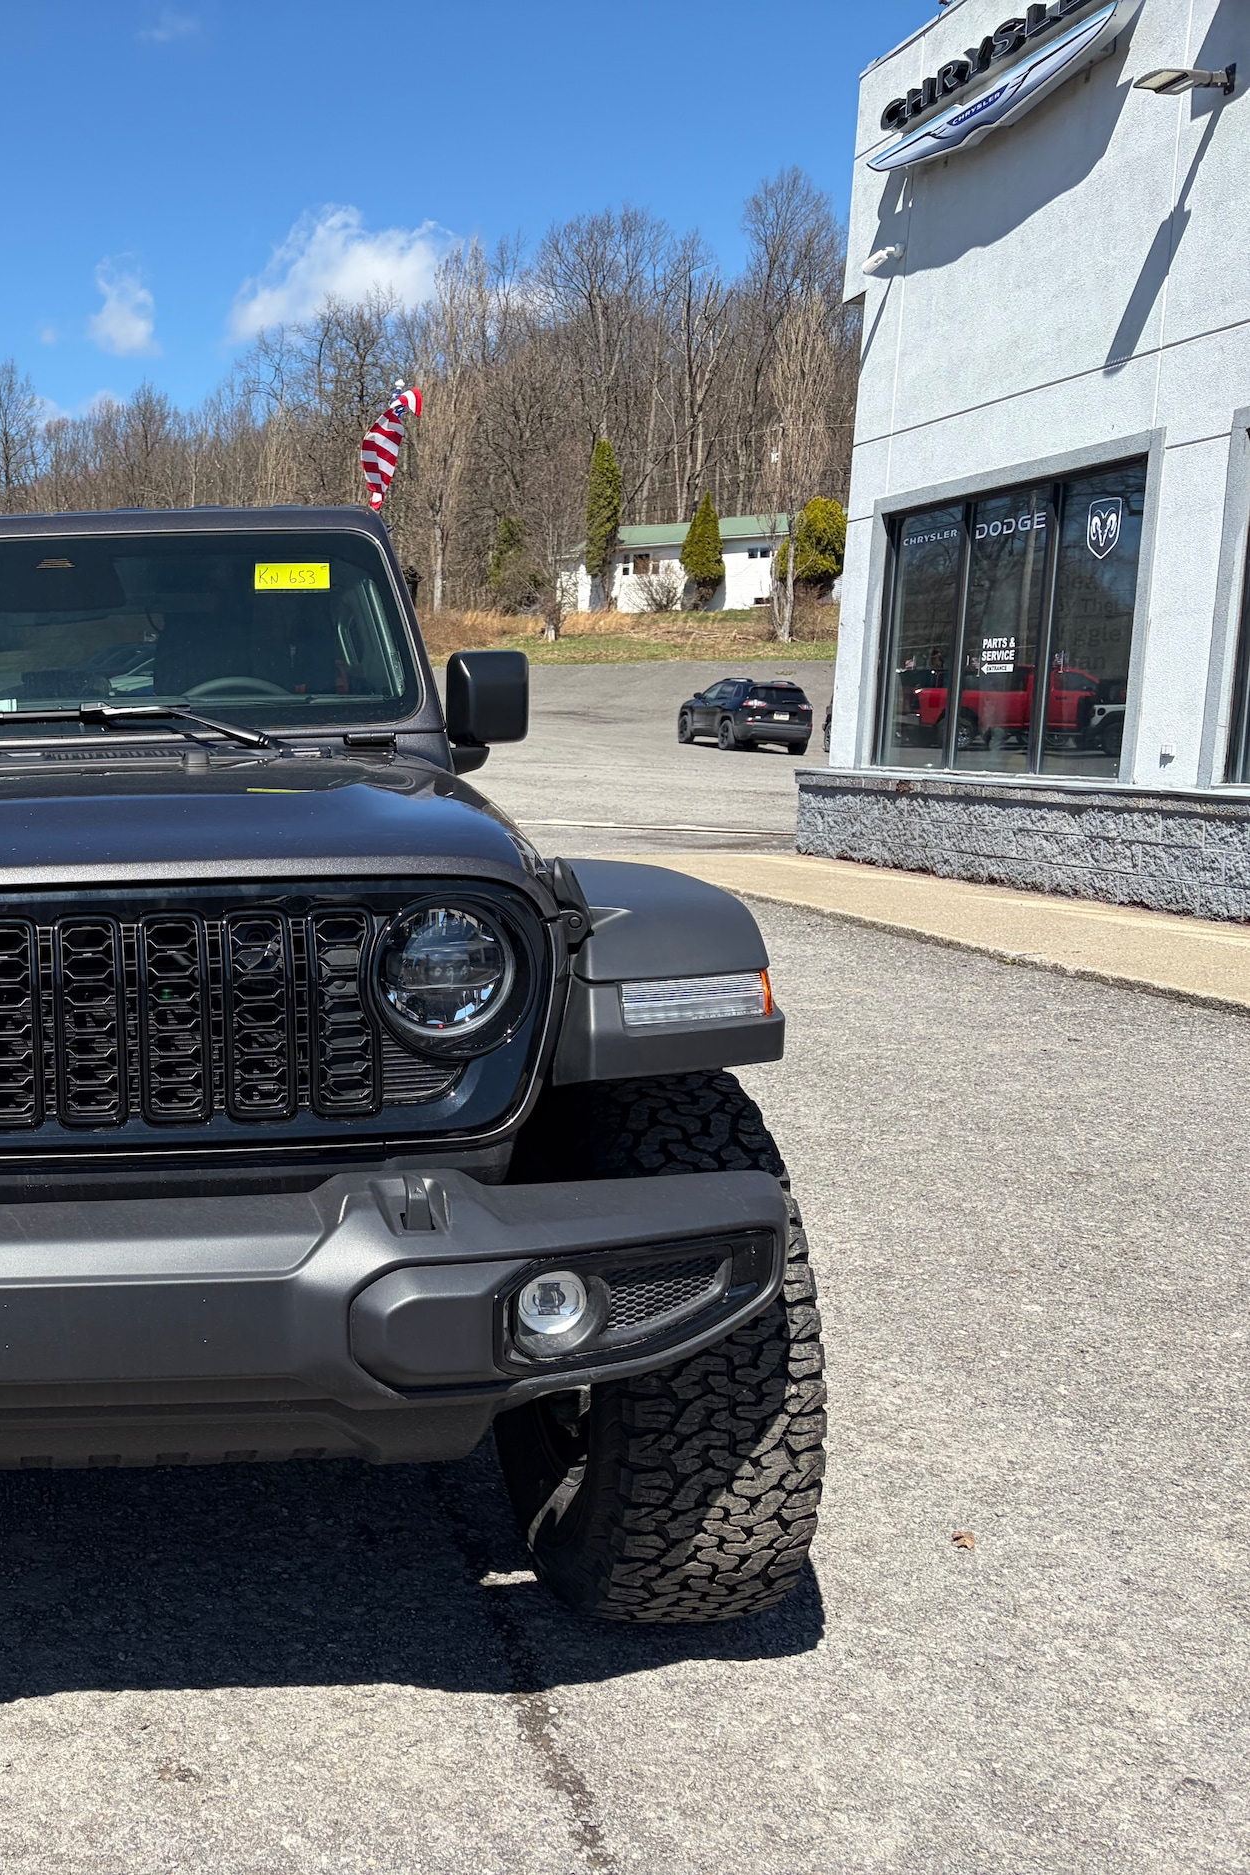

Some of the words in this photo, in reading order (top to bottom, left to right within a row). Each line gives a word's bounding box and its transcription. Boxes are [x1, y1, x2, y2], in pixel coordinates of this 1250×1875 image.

[952, 92, 1001, 126] CHRYSLER
[975, 512, 1047, 539] DODGE
[903, 529, 958, 547] CHRYSLER
[289, 569, 316, 585] 653
[982, 637, 1008, 649] PARTS
[1009, 637, 1016, 648] &
[981, 650, 1015, 661] SERVICE
